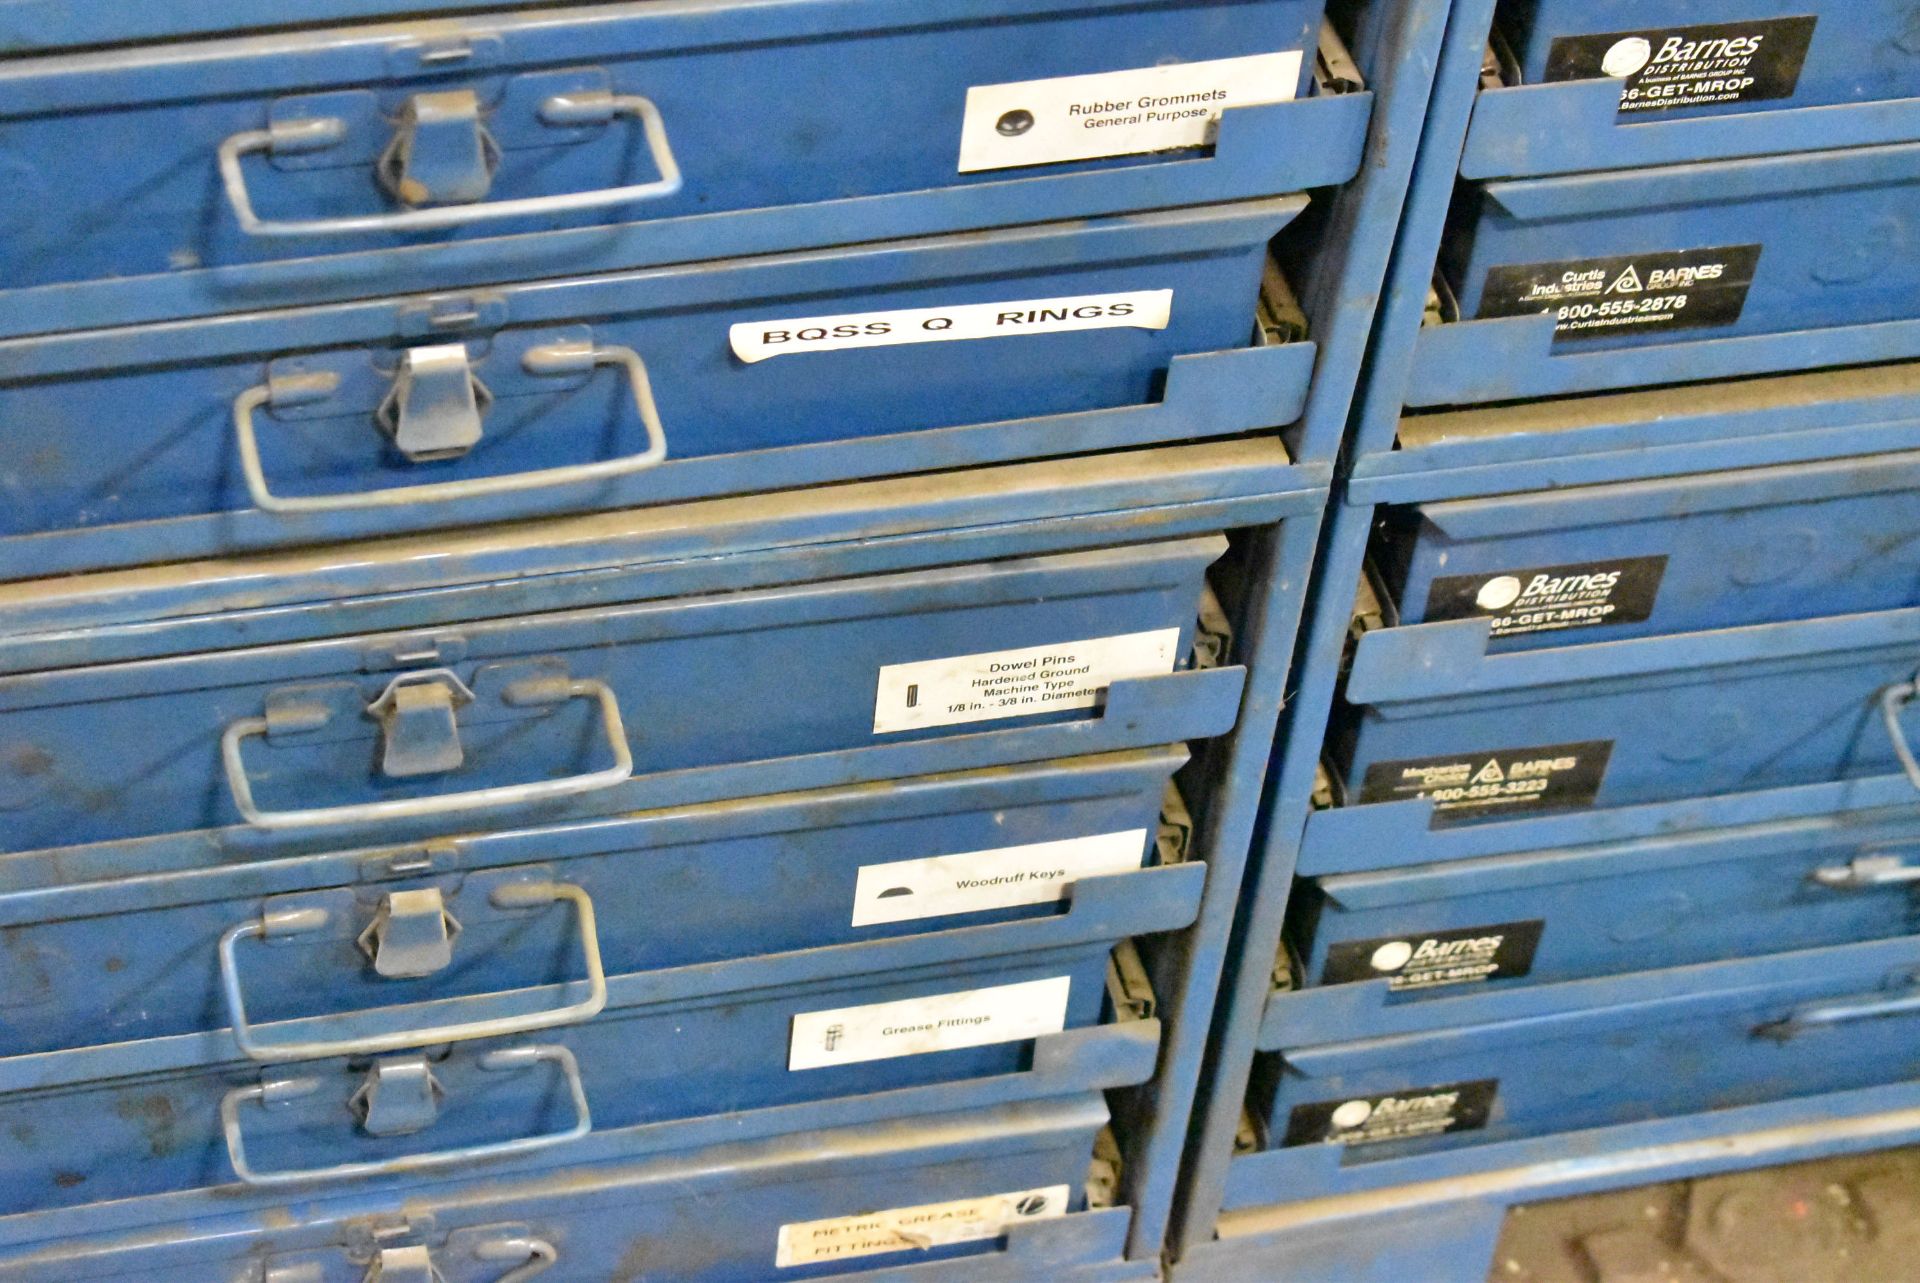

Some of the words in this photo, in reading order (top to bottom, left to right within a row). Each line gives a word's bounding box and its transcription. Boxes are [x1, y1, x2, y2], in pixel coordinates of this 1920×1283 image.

[1651, 35, 1763, 64] Barnes
[1643, 56, 1753, 76] DISTRIBUTION
[1680, 72, 1708, 81] BARNES
[1069, 98, 1132, 117] Rubber
[1138, 88, 1227, 109] Grommets
[1084, 113, 1142, 129] General
[1147, 106, 1208, 125] Purpose
[1562, 268, 1606, 284] Curtis
[1649, 264, 1724, 284] BARNES
[996, 302, 1135, 326] RINGS
[1521, 570, 1622, 598] Barnes
[1515, 588, 1613, 607] DISTRIBUTION
[989, 658, 1037, 673] Dowel
[1042, 653, 1075, 666] Pins
[971, 672, 1034, 688] Hardened
[1040, 664, 1090, 680] Ground
[984, 682, 1038, 698] Machine
[1044, 679, 1074, 694] Type
[946, 702, 966, 714] 1/8
[969, 700, 985, 711] in.
[998, 696, 1018, 708] 3/8
[1021, 694, 1037, 704] in.
[956, 872, 1026, 890] Woodruff
[1029, 868, 1066, 884] Keys
[882, 1022, 934, 1036] Grease
[937, 1014, 992, 1030] Fittings
